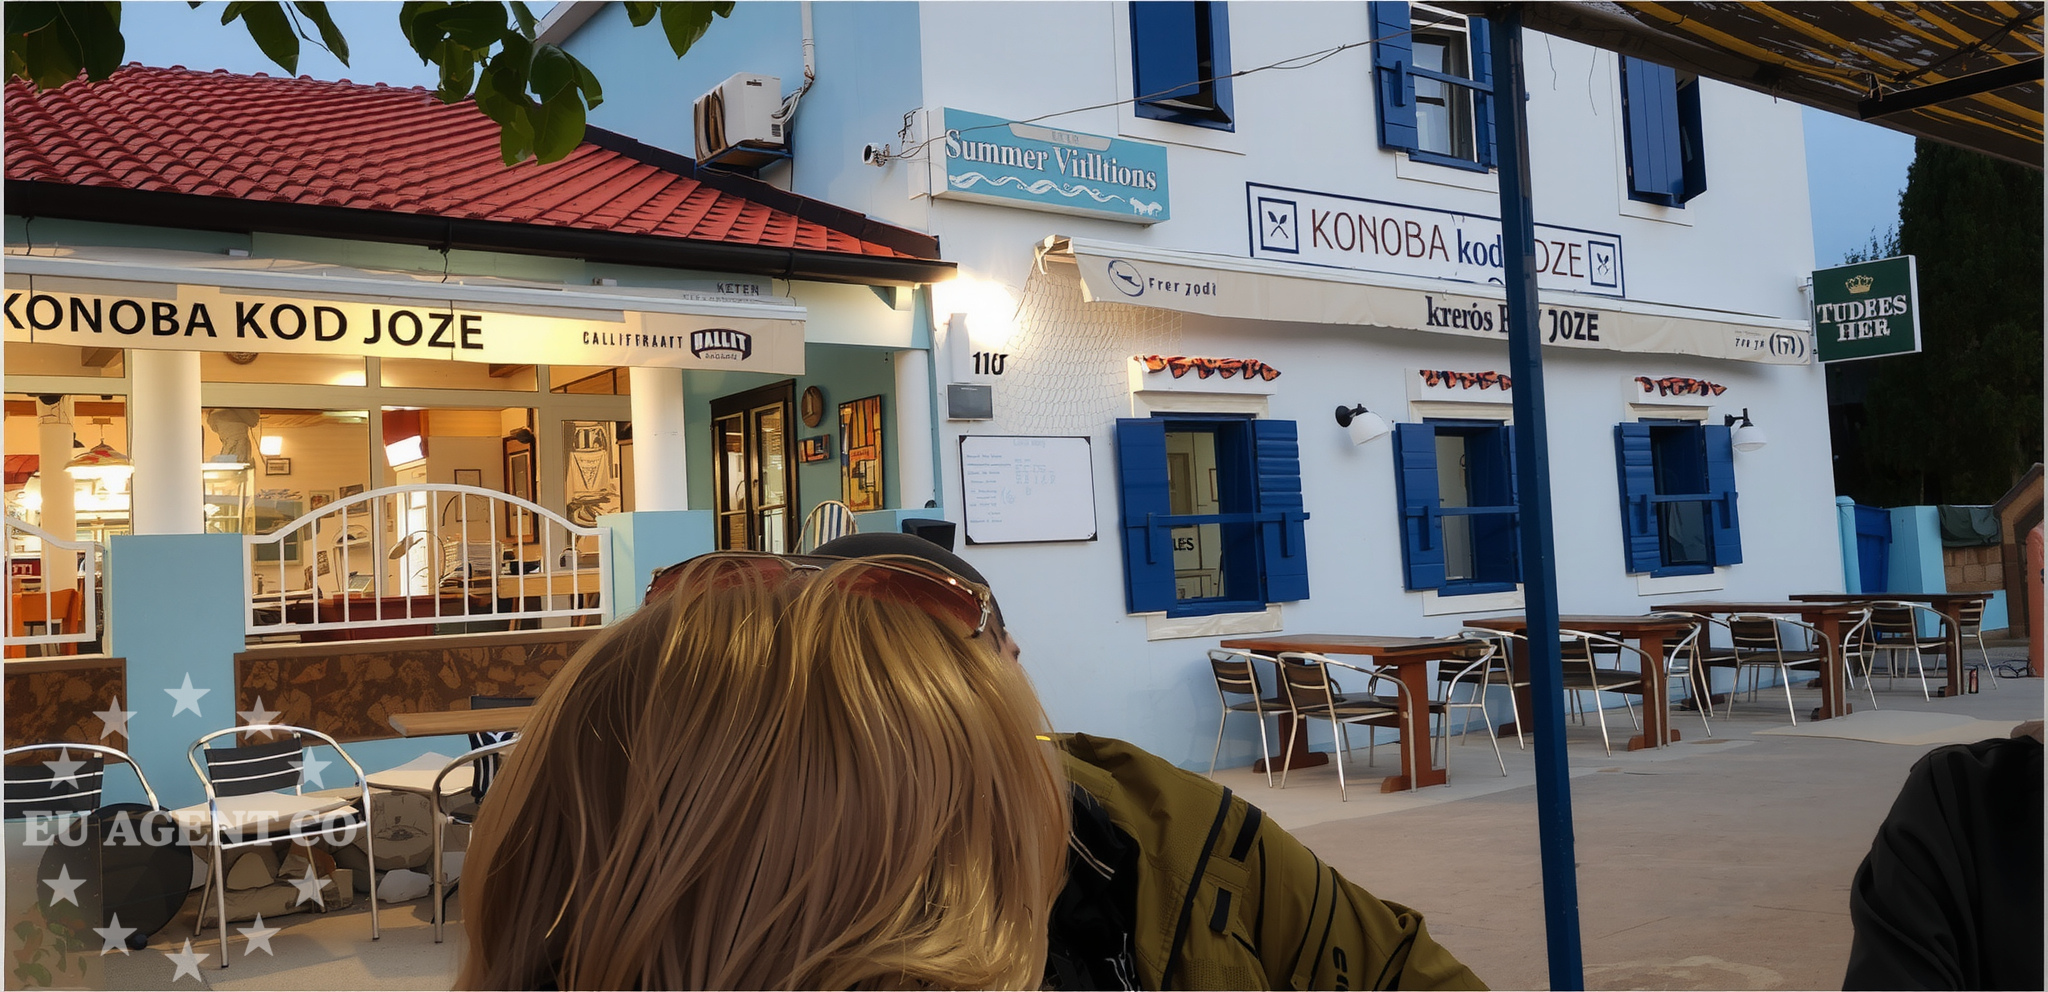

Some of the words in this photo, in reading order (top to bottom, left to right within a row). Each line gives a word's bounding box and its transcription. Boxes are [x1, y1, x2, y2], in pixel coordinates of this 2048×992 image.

[945, 128, 1049, 172] Summer
[1311, 208, 1449, 263] KONOBA
[1456, 228, 1504, 268] kod
[1534, 239, 1585, 278] OZE
[4, 292, 217, 338] KONOBA
[235, 301, 348, 342] KOD
[363, 308, 484, 350] JOZE
[1548, 309, 1600, 343] JOZE
[1836, 317, 1891, 343] HER
